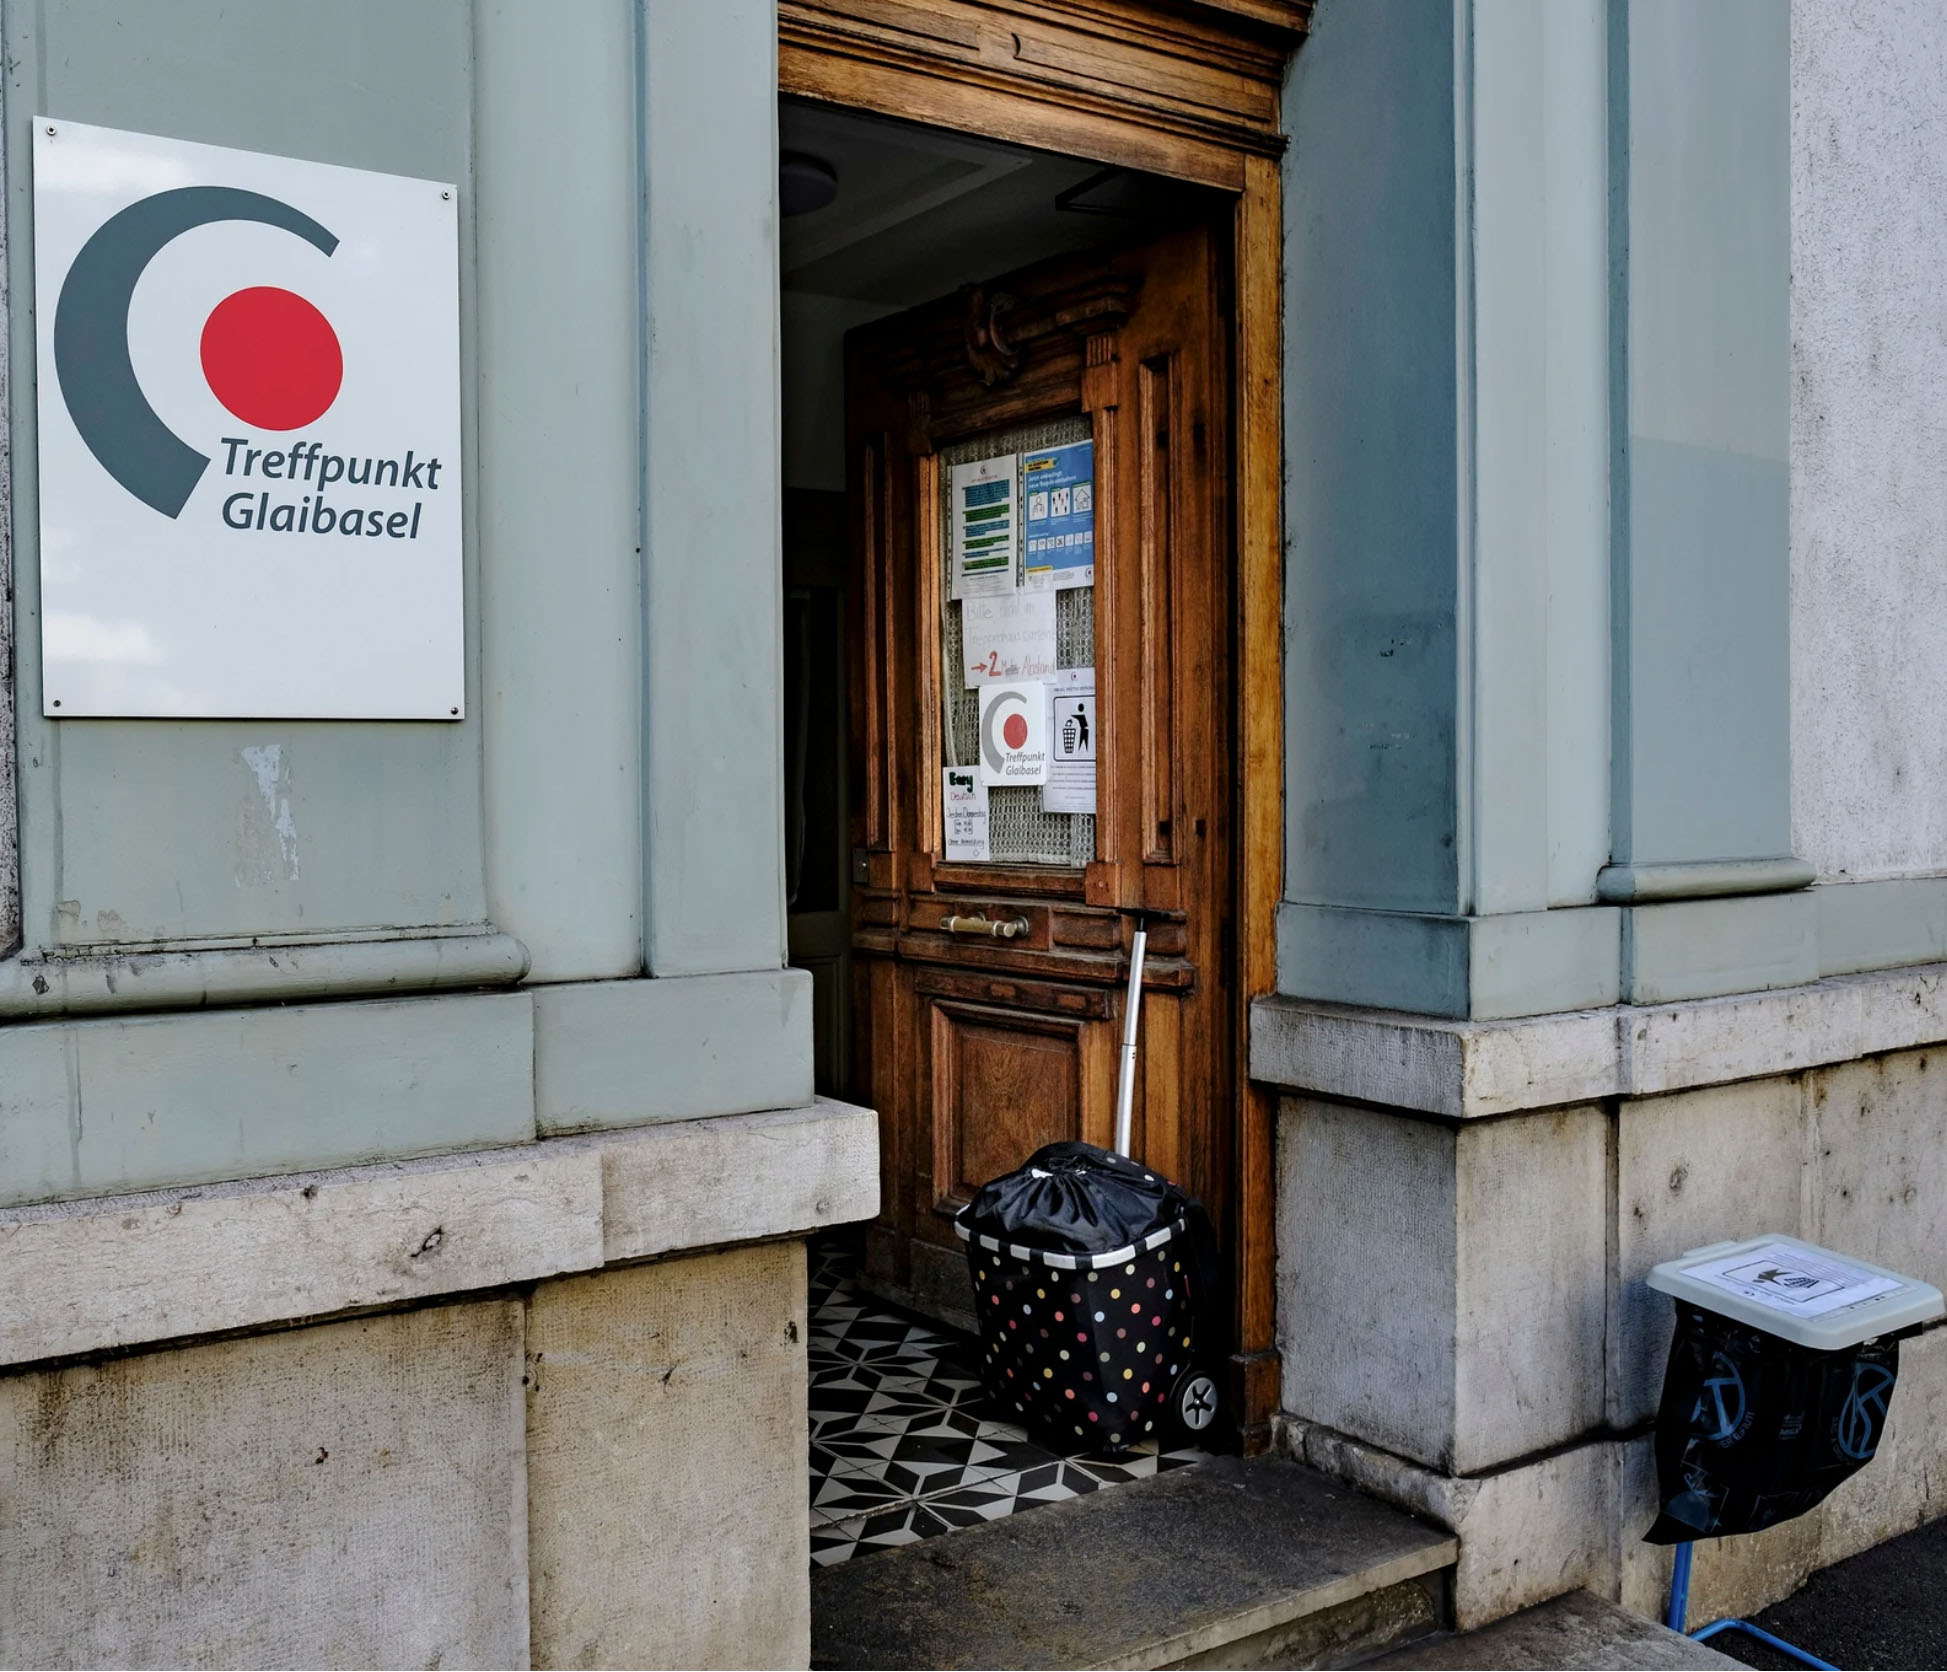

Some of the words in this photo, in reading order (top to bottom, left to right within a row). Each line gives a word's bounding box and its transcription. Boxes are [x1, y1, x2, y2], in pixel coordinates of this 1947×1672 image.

[221, 437, 442, 491] Treffpunkt
[222, 492, 422, 538] Glaibasel
[988, 651, 1001, 677] 2
[1006, 752, 1045, 767] Treffpunkt
[1006, 764, 1042, 776] Glaibasel
[949, 771, 974, 793] Easy
